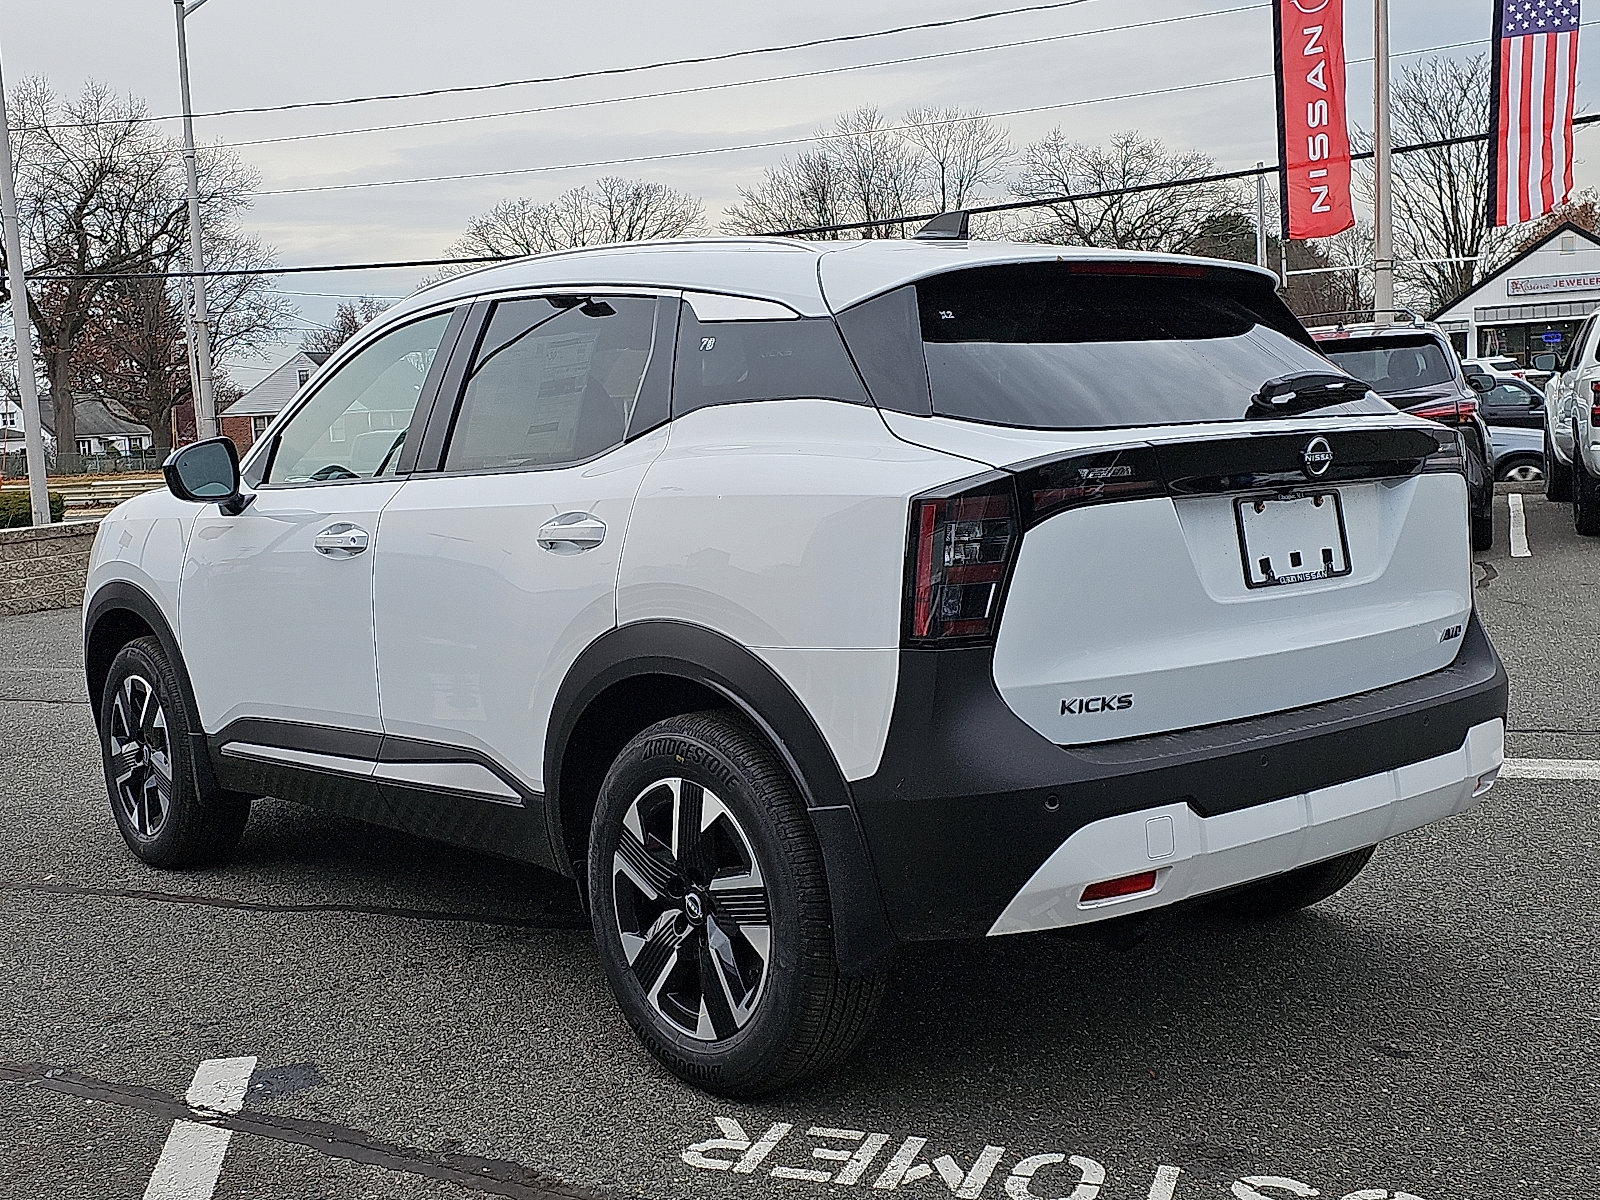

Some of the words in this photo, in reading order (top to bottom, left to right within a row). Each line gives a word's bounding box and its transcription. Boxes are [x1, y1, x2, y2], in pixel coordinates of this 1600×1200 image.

[1302, 24, 1331, 214] NISSAN
[1304, 453, 1333, 462] NISSAN
[1297, 570, 1328, 582] NISSAN
[1060, 693, 1133, 716] KICKS
[641, 739, 741, 792] BRIDGESTONE
